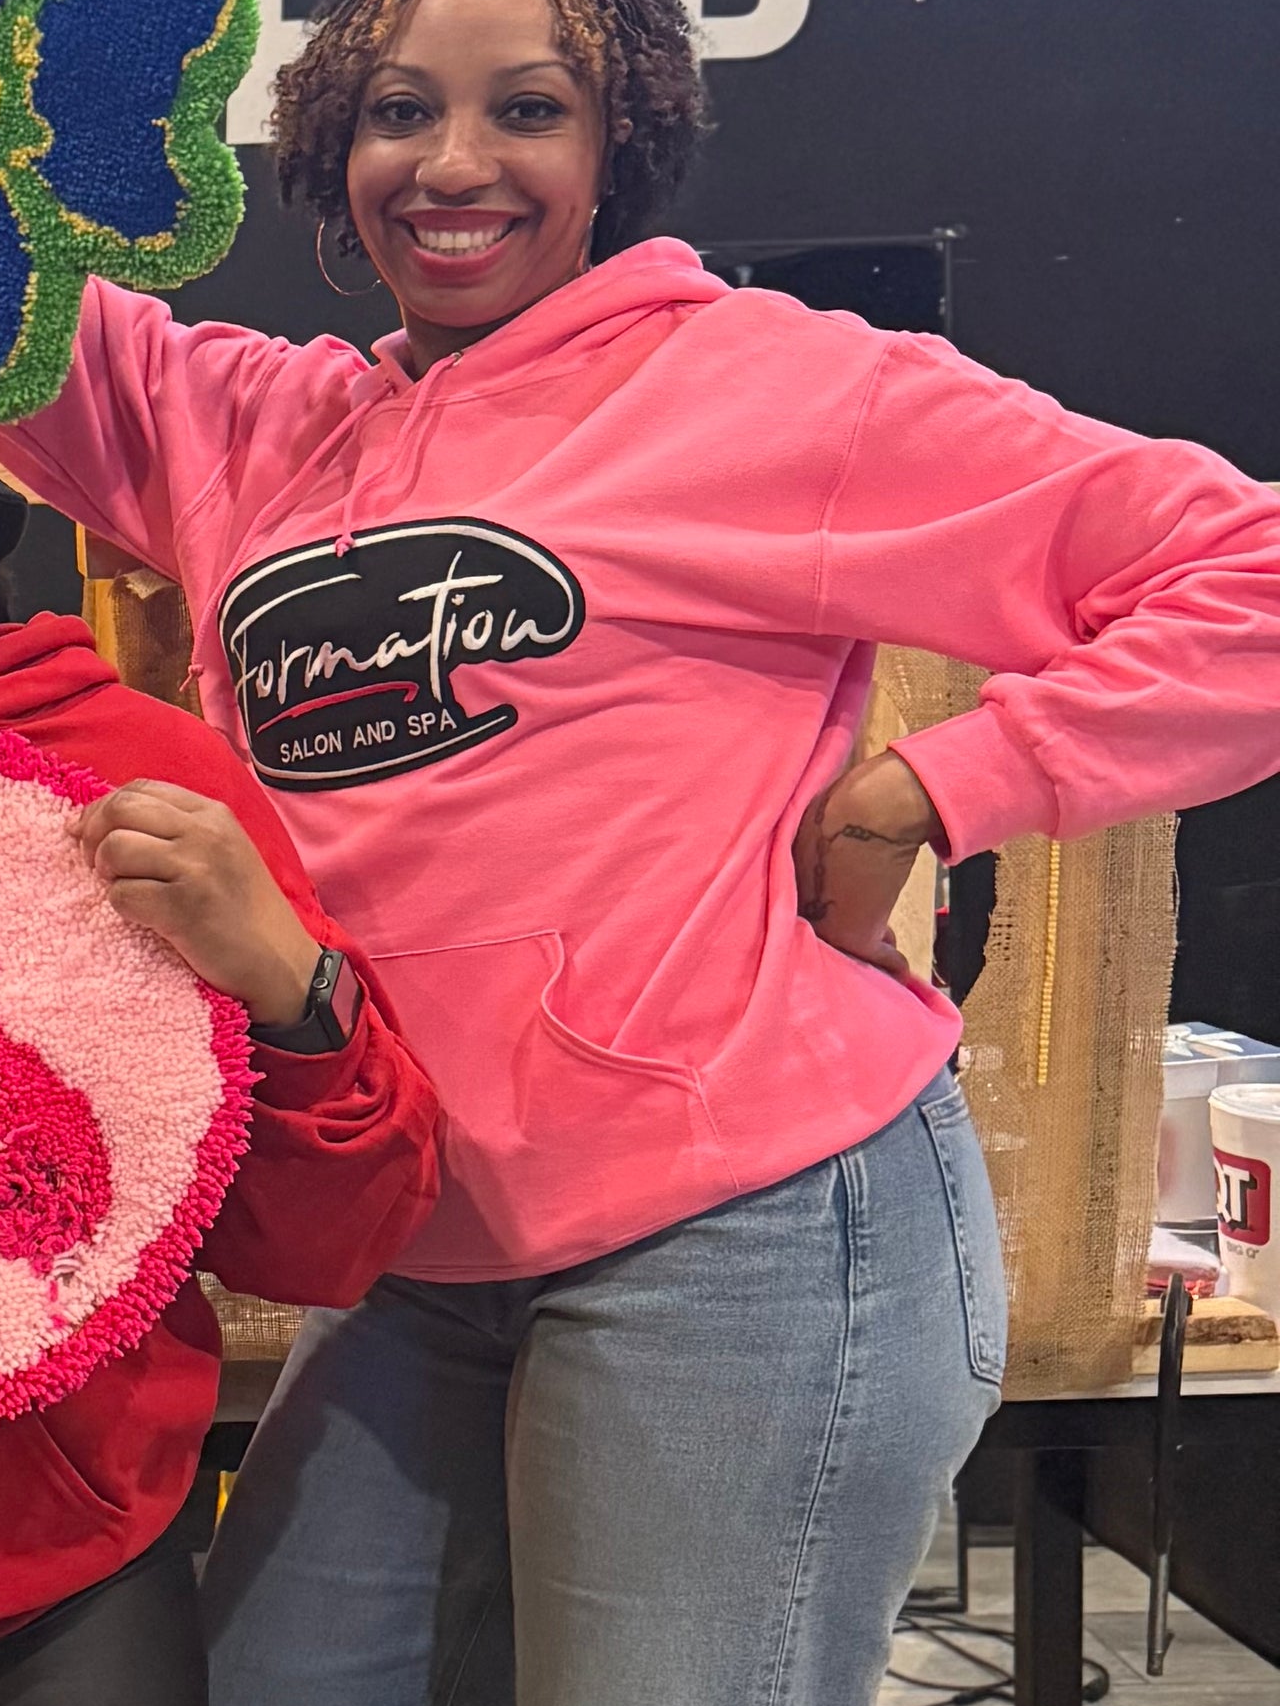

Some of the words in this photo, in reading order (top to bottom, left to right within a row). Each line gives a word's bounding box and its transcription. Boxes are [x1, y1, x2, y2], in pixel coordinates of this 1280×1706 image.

[280, 729, 342, 764] SALON
[353, 719, 396, 750] AND
[407, 708, 457, 738] SPA
